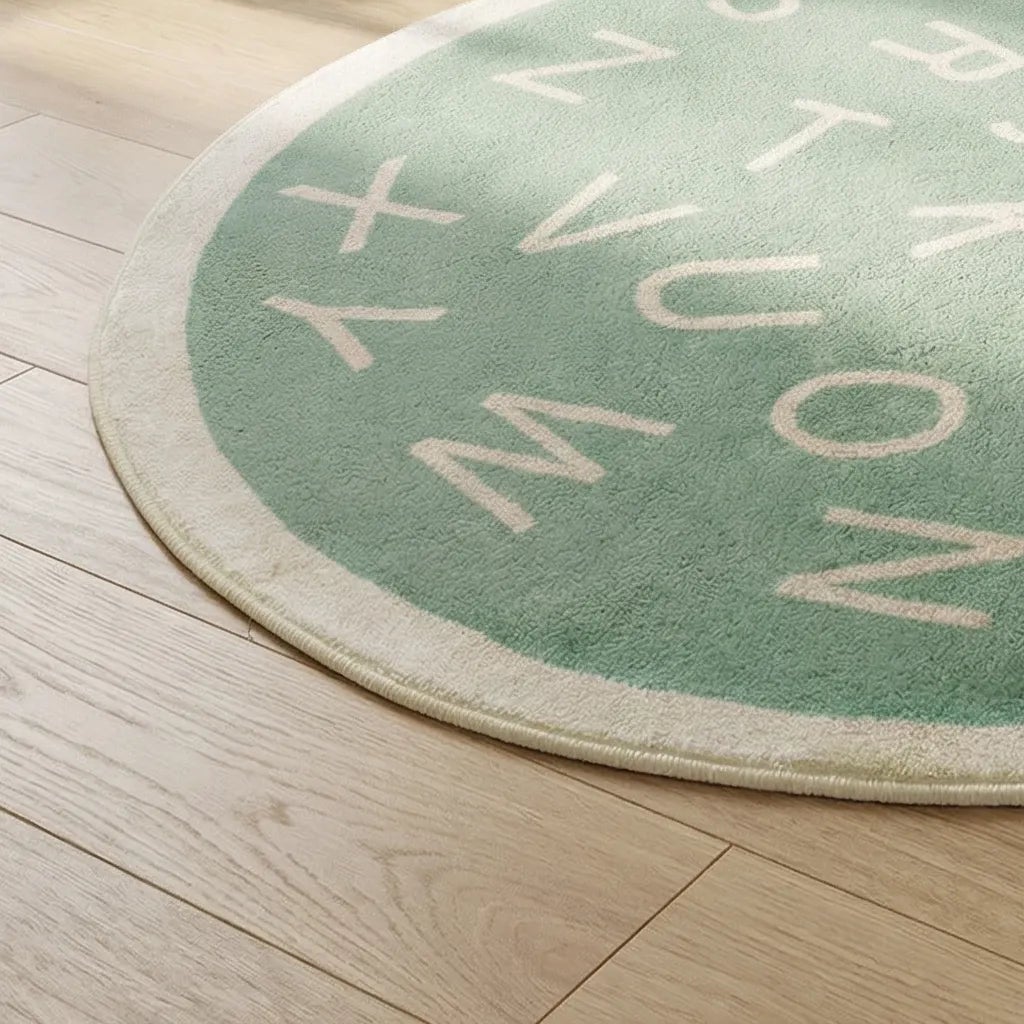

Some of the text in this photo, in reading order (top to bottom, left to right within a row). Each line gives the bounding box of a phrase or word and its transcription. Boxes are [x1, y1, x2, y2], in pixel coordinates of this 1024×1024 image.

[747, 98, 890, 174] T
[281, 157, 464, 253] X
[517, 173, 704, 255] V
[635, 254, 824, 333] U
[771, 370, 967, 460] O
[409, 393, 677, 534] W
